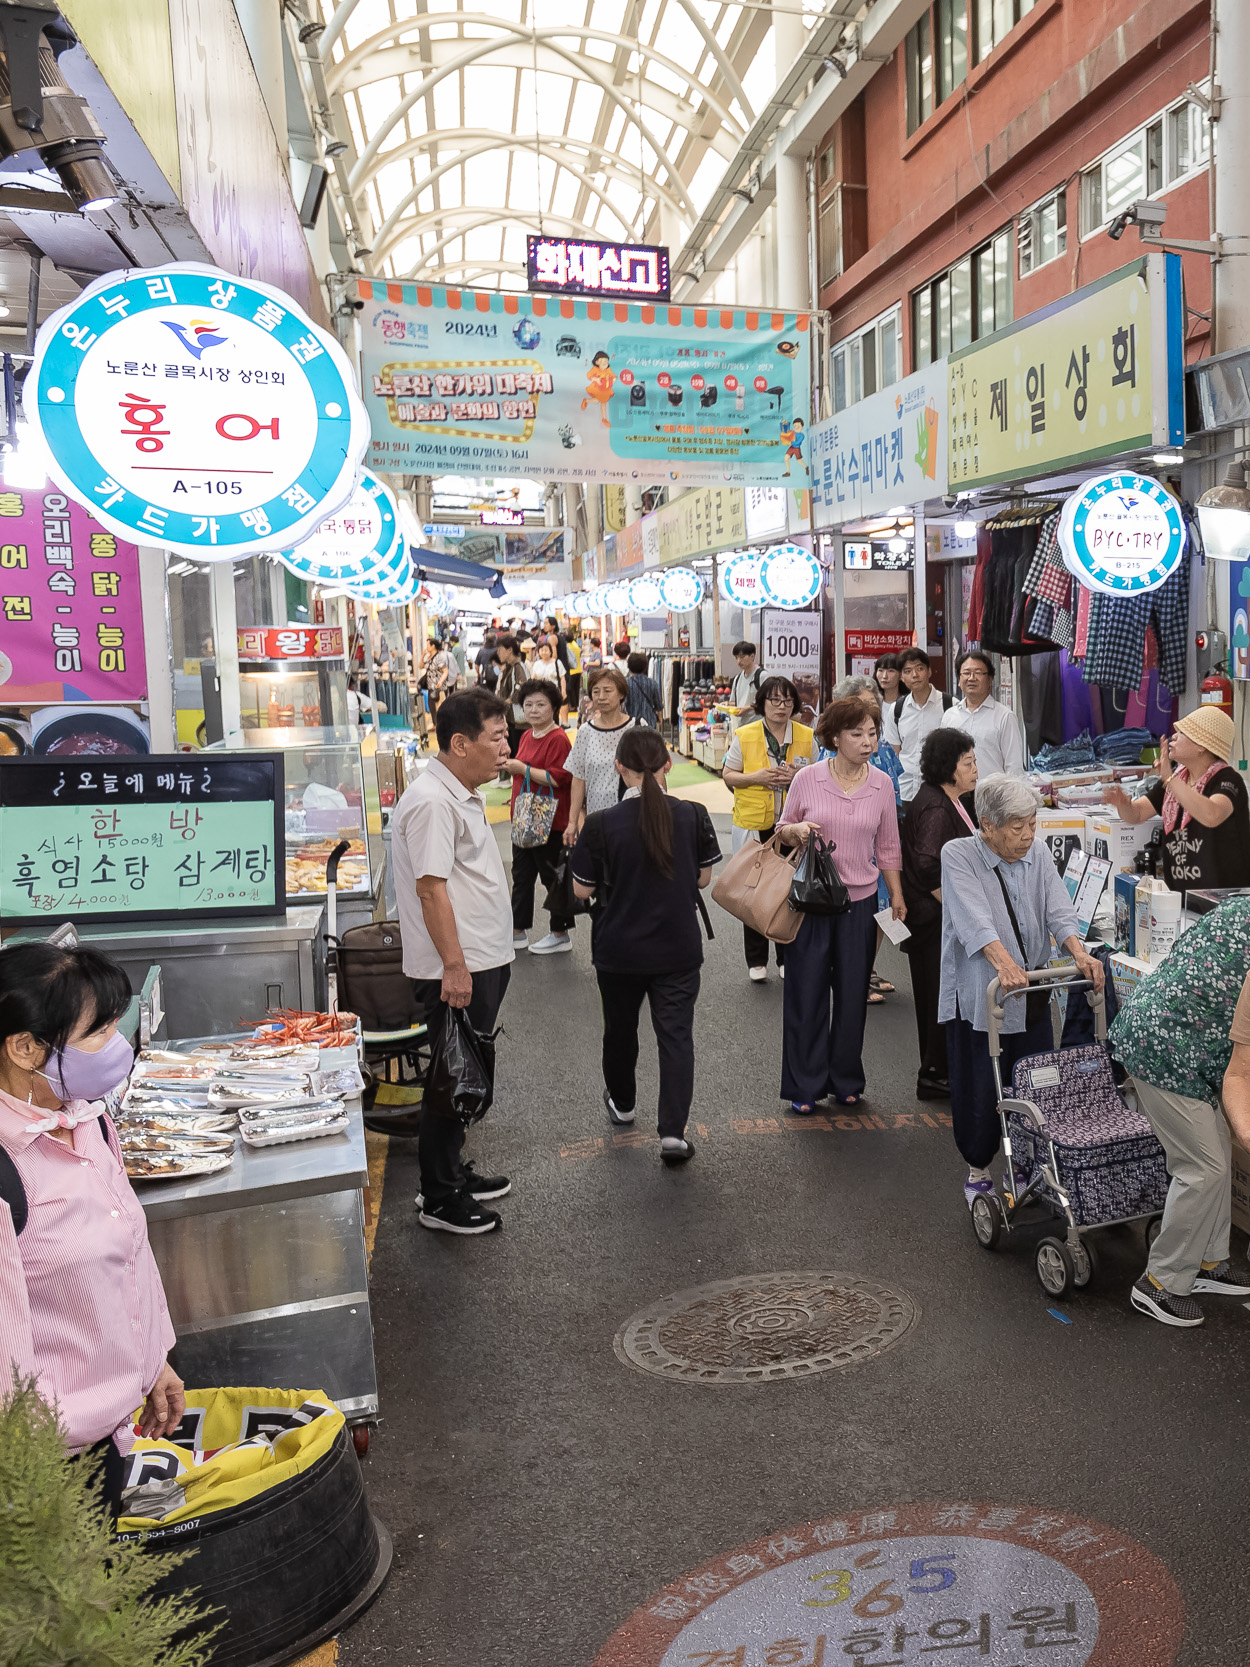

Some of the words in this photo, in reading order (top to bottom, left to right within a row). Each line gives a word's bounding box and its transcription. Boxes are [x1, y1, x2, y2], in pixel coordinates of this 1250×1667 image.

[62, 276, 325, 364] 온누리상품권
[445, 321, 498, 338] 2024년
[106, 360, 157, 378] 노룬산
[164, 362, 231, 383] 골목시장
[237, 368, 286, 386] 상인회
[372, 373, 432, 397] 노룬산
[434, 373, 493, 396] 한가위
[495, 372, 553, 394] 대축제
[989, 323, 1136, 434] 제일상회
[415, 443, 447, 456] 2024년
[812, 427, 904, 506] 노룬산수퍼마켓
[173, 480, 243, 496] A-105
[94, 477, 317, 544] 카드가맹점
[275, 631, 310, 655] 왕
[767, 635, 819, 659] 1,000원
[864, 634, 911, 645] 비상소화장치
[78, 772, 144, 793] 오늘에
[1175, 854, 1187, 866] OF
[12, 853, 149, 897] 흑염소탕
